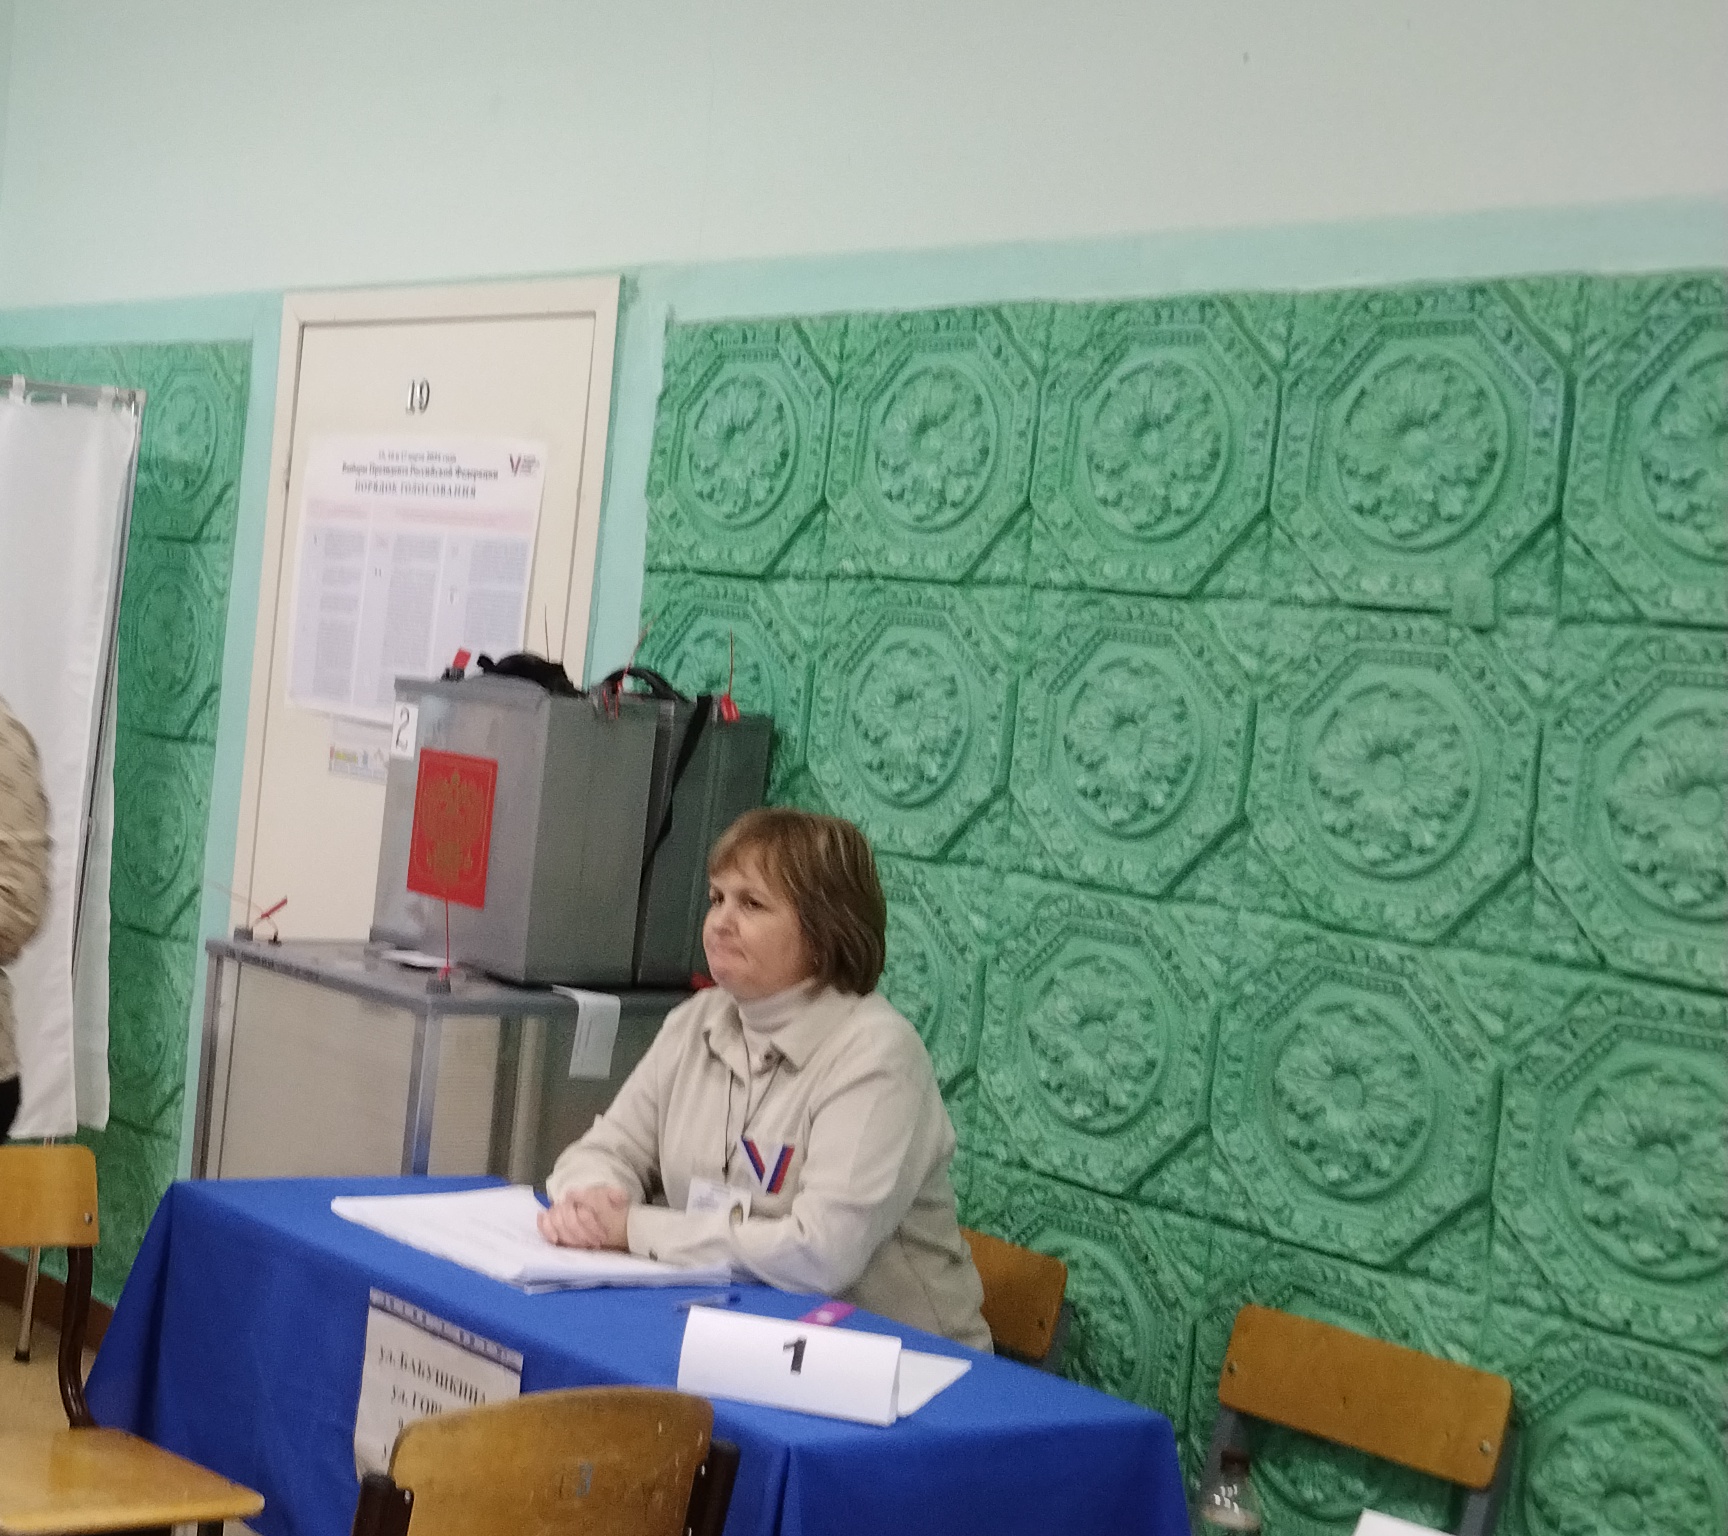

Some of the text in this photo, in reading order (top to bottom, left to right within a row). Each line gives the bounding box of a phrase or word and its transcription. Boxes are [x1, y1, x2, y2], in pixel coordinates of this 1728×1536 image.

[395, 707, 410, 751] 2
[783, 1336, 807, 1375] 1
[400, 1351, 486, 1407] БАБУШКИНА
